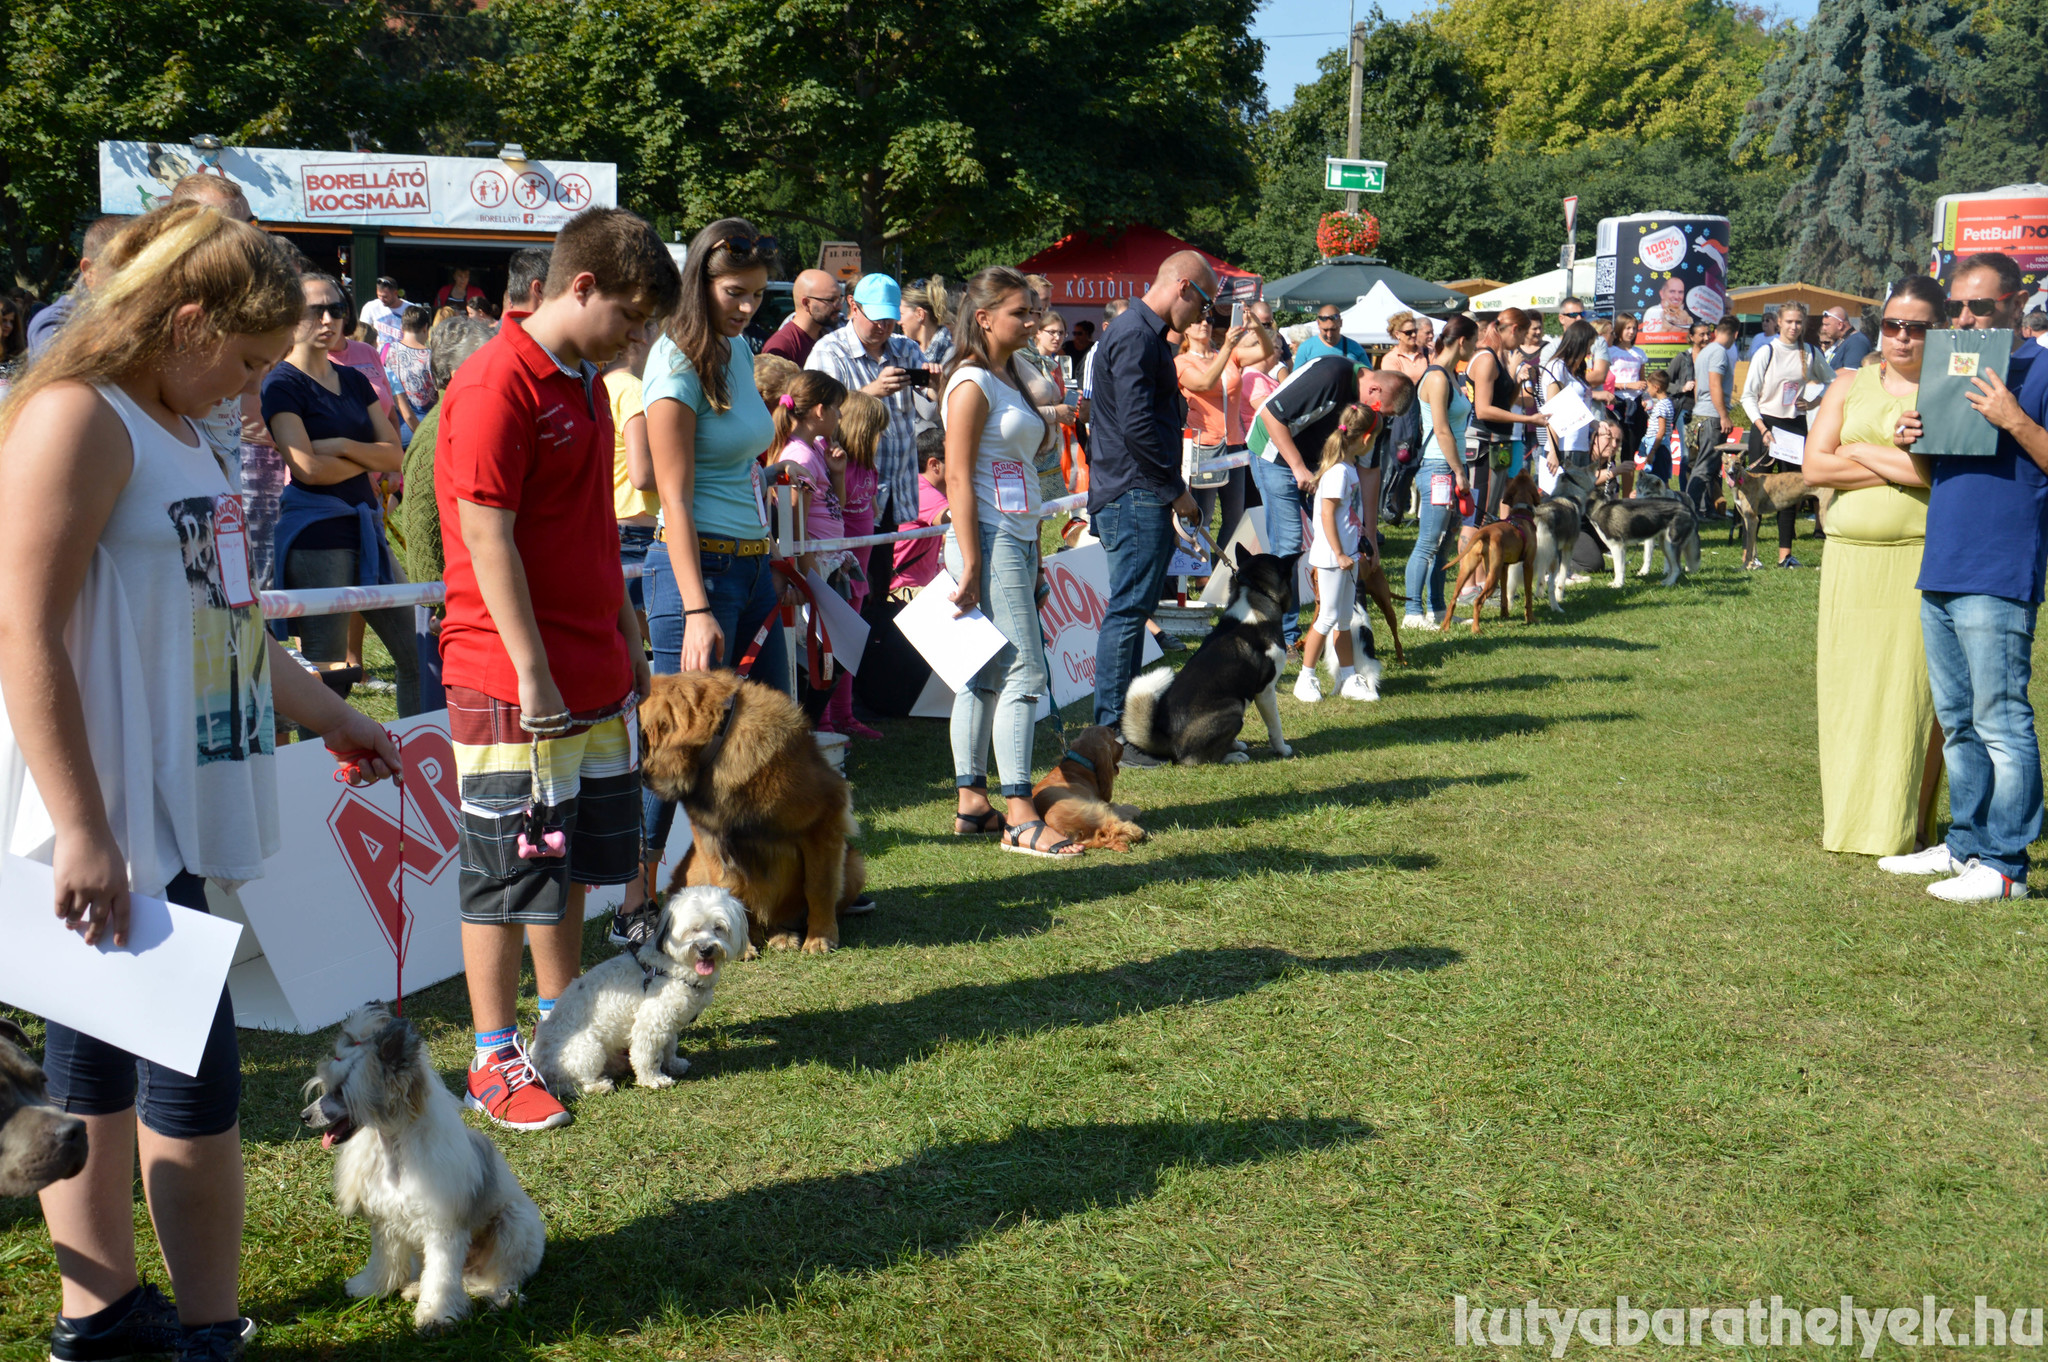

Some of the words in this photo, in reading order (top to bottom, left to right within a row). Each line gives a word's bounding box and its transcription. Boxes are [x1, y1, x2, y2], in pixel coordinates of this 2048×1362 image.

[306, 168, 426, 191] BORELLÁTÓ
[309, 188, 427, 211] KOCSMÁJA
[1963, 225, 2048, 241] PettBullDO
[1645, 237, 1680, 256] 100%
[1066, 277, 1134, 299] KÓSTOLT
[994, 462, 1023, 477] ARION
